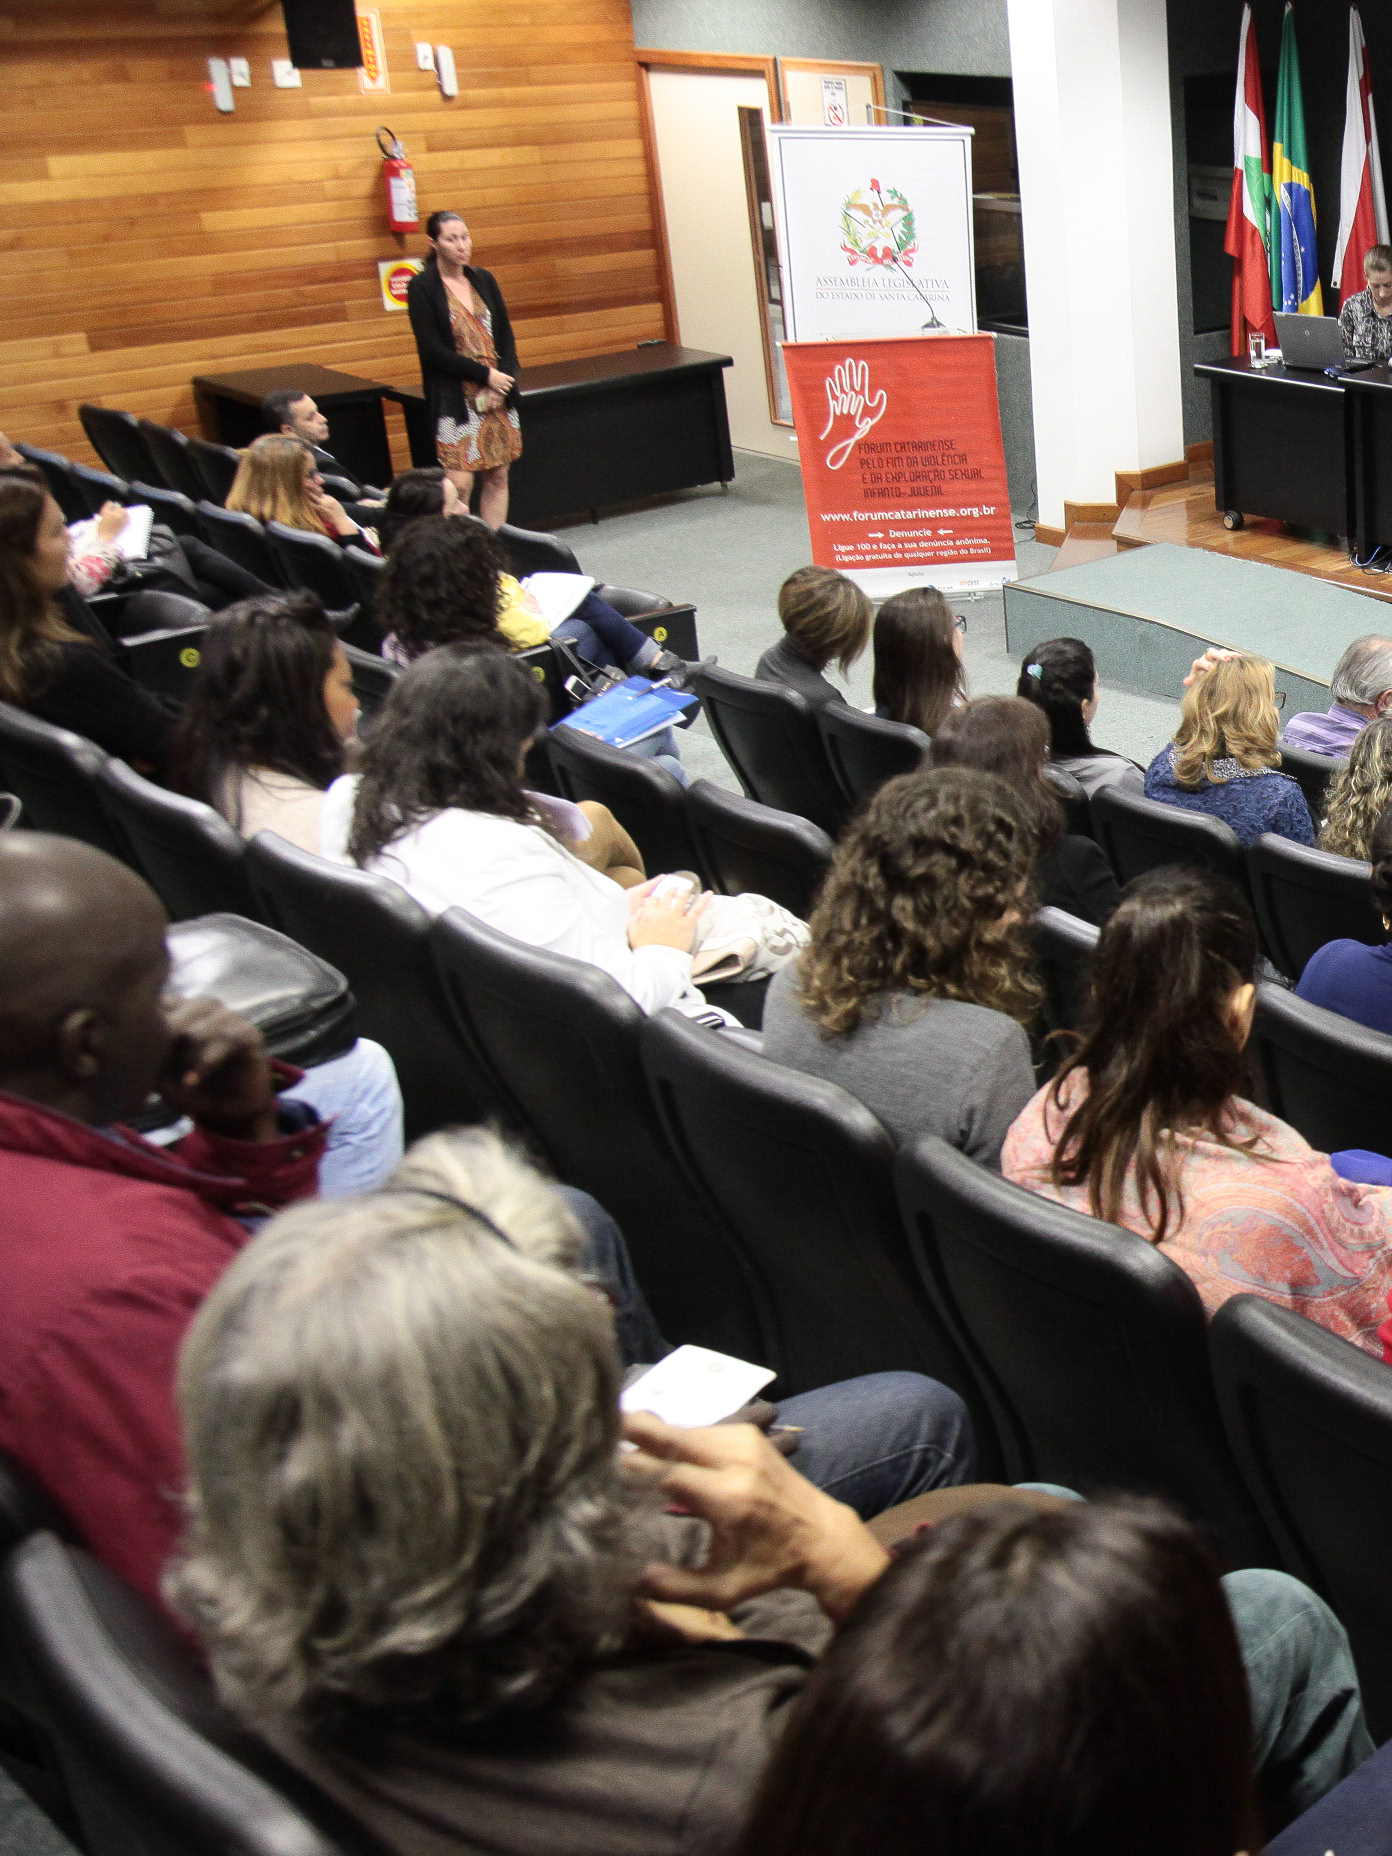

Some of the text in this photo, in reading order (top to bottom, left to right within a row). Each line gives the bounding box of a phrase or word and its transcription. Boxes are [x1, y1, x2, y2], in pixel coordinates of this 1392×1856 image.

[815, 276, 879, 288] ASSEMBLEIA
[815, 291, 830, 300] DO
[831, 291, 864, 301] ESTADO
[865, 292, 877, 301] DE
[879, 293, 906, 301] SANTA
[894, 439, 957, 453] CATARINENSE
[859, 456, 884, 470] PELO
[886, 456, 904, 469] FIM
[906, 455, 919, 468] DA
[862, 472, 868, 484] E
[870, 471, 883, 484] DA
[948, 467, 984, 481] SEXUAL
[820, 505, 996, 522] www.forumcatarinense.org.br
[888, 528, 933, 538] Denuncie
[833, 543, 855, 552] Ligue
[857, 542, 871, 551] 100
[880, 541, 896, 551] faça
[919, 539, 954, 548] denúncia
[956, 537, 990, 546] anônima.
[835, 554, 864, 563] (Ligação
[865, 552, 892, 562] gratuita
[904, 550, 935, 560] qualquer
[936, 548, 958, 558] região
[959, 547, 968, 555] do
